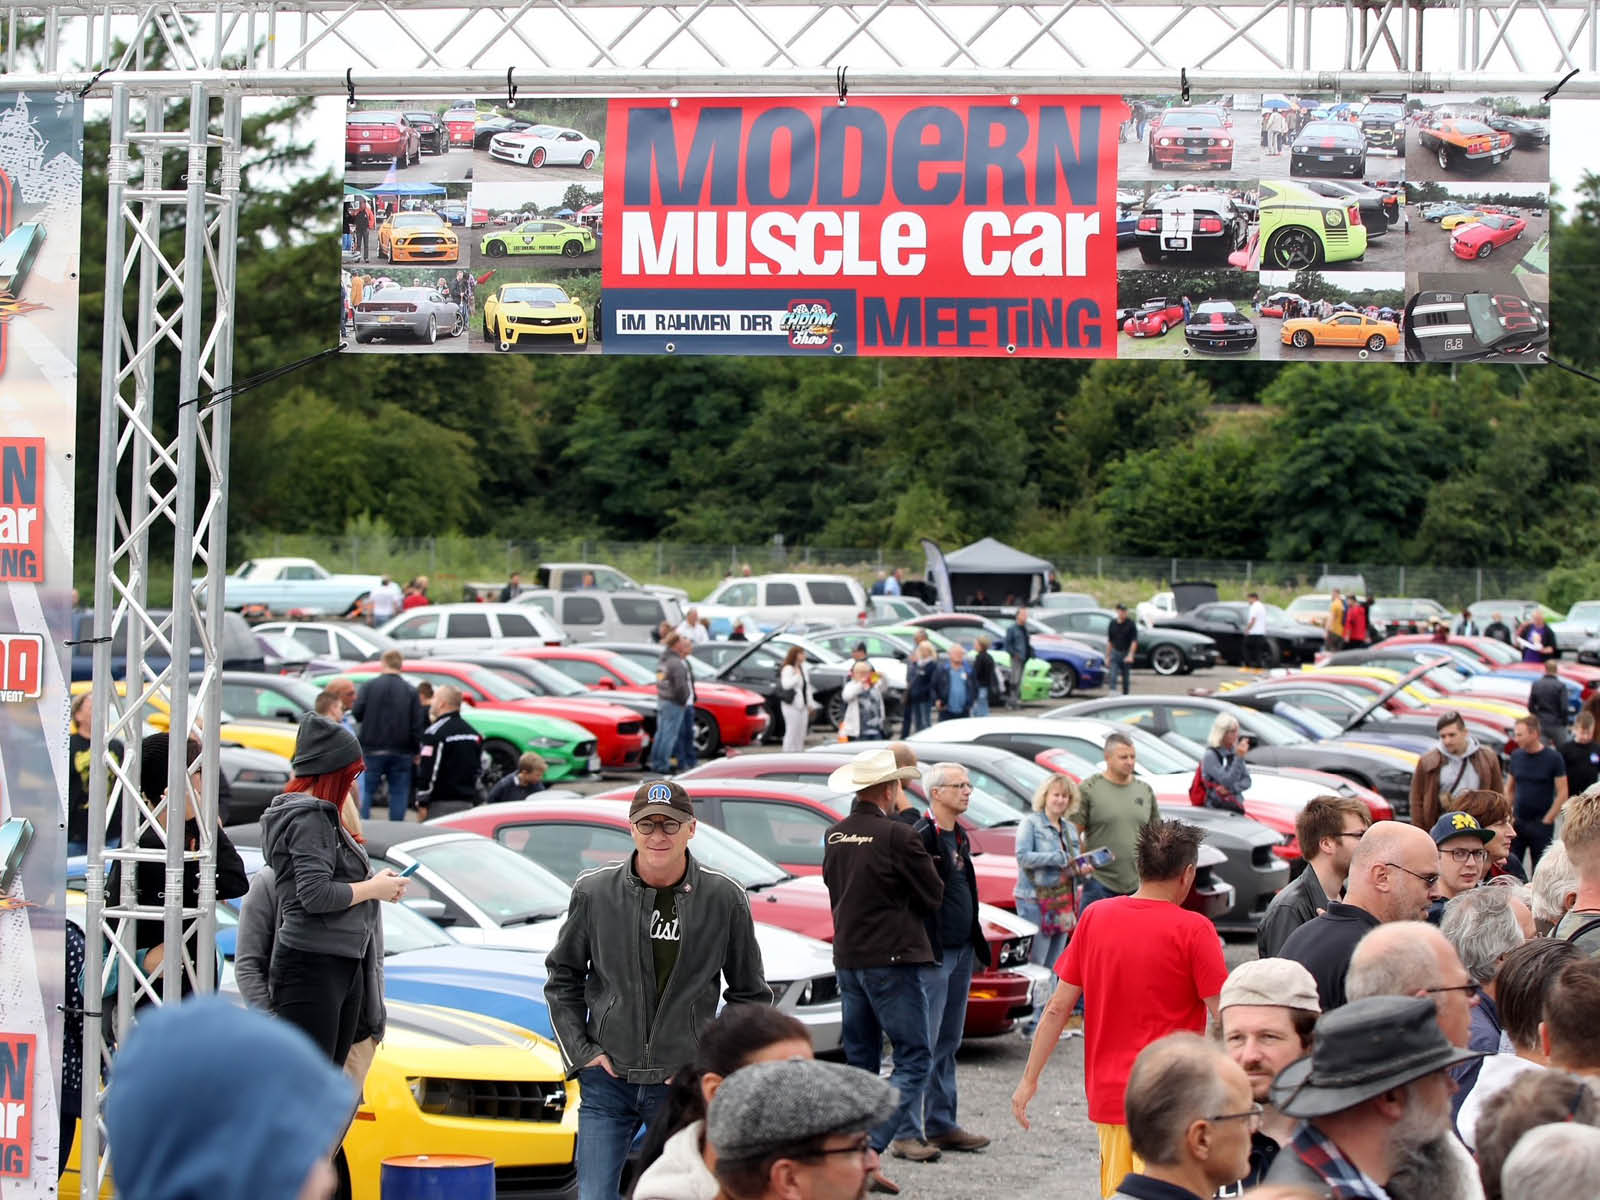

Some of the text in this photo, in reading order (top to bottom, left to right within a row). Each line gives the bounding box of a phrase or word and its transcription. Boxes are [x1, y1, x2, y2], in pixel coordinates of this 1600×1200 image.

[655, 314, 731, 331] RAHMEN
[740, 314, 773, 332] DER
[0, 507, 37, 545] ar
